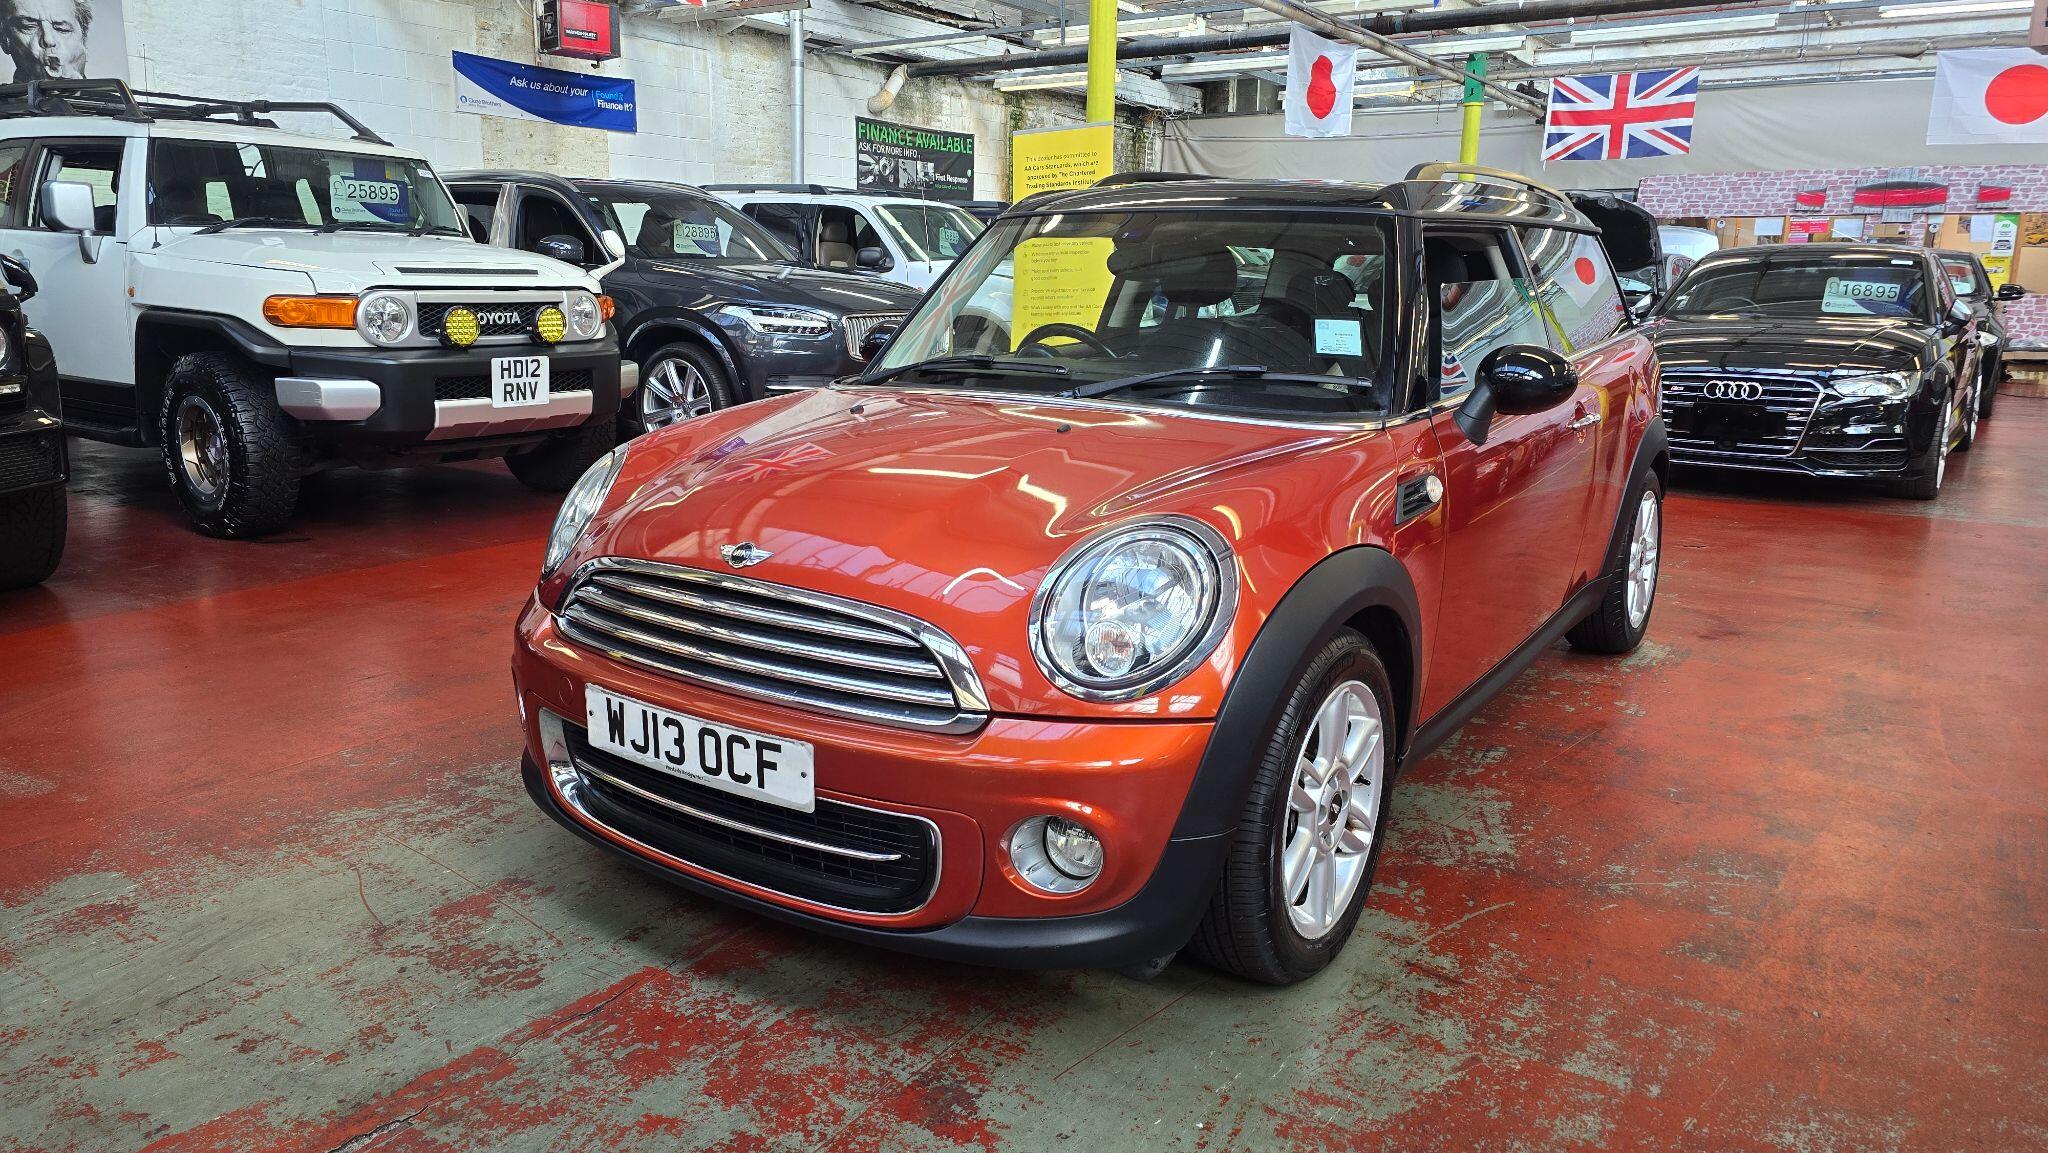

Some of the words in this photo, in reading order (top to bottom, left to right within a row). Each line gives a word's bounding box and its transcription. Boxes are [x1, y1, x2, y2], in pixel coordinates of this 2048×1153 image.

[510, 76, 528, 89] Ask
[530, 82, 541, 90] us
[543, 82, 569, 95] about
[570, 86, 589, 98] your
[597, 99, 624, 111] Finance
[624, 101, 633, 112] it?
[858, 121, 913, 147] FINANCE
[915, 132, 973, 154] AVAILABLE
[858, 141, 872, 152] ASK
[872, 143, 886, 153] FOR
[885, 145, 903, 157] MORE
[935, 173, 946, 182] First
[946, 174, 968, 184] Response
[478, 311, 522, 325] OYOTA
[500, 358, 541, 380] HD12
[503, 381, 539, 402] RNV
[605, 697, 686, 766] WJ13
[698, 727, 782, 790] OCF
